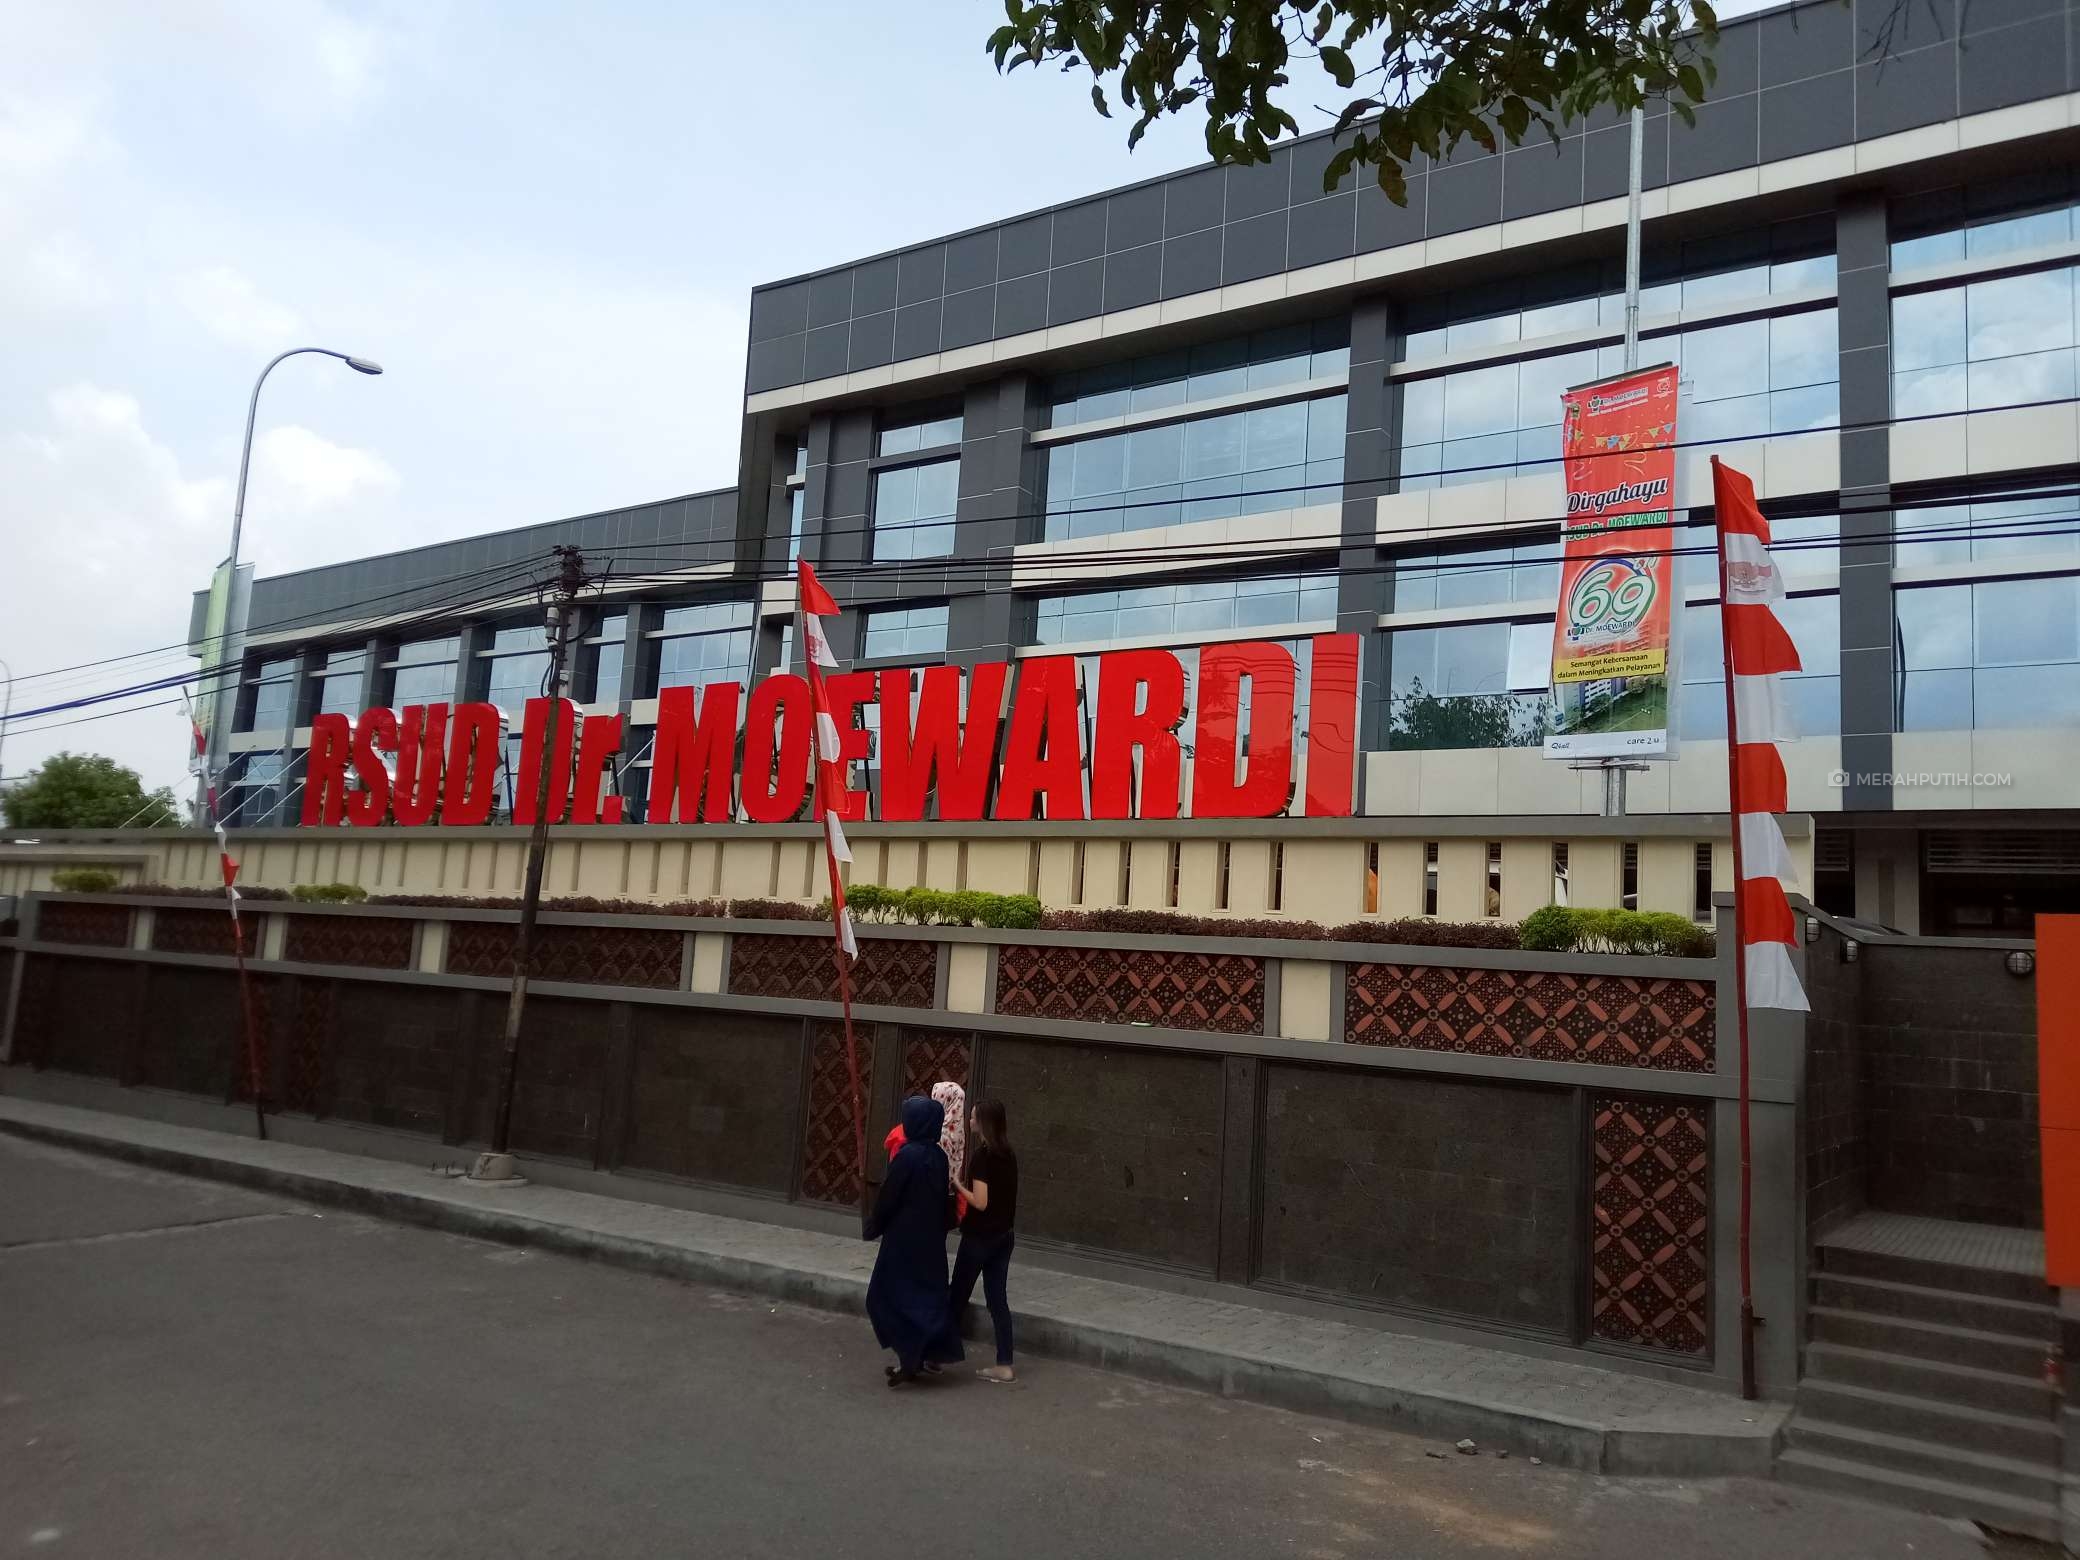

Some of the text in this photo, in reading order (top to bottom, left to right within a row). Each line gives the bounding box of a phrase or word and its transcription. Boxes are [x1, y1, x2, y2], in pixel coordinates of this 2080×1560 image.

[1567, 478, 1668, 513] Dirgahayu
[1569, 571, 1656, 627] 69
[1596, 620, 1635, 632] MOEWARDI
[1557, 662, 1661, 679] dalam Meningkatkan Pelayanan
[1570, 653, 1648, 668] Semangat Kebersamaan
[300, 633, 1364, 826] RSUD Dr. MOEWARDI
